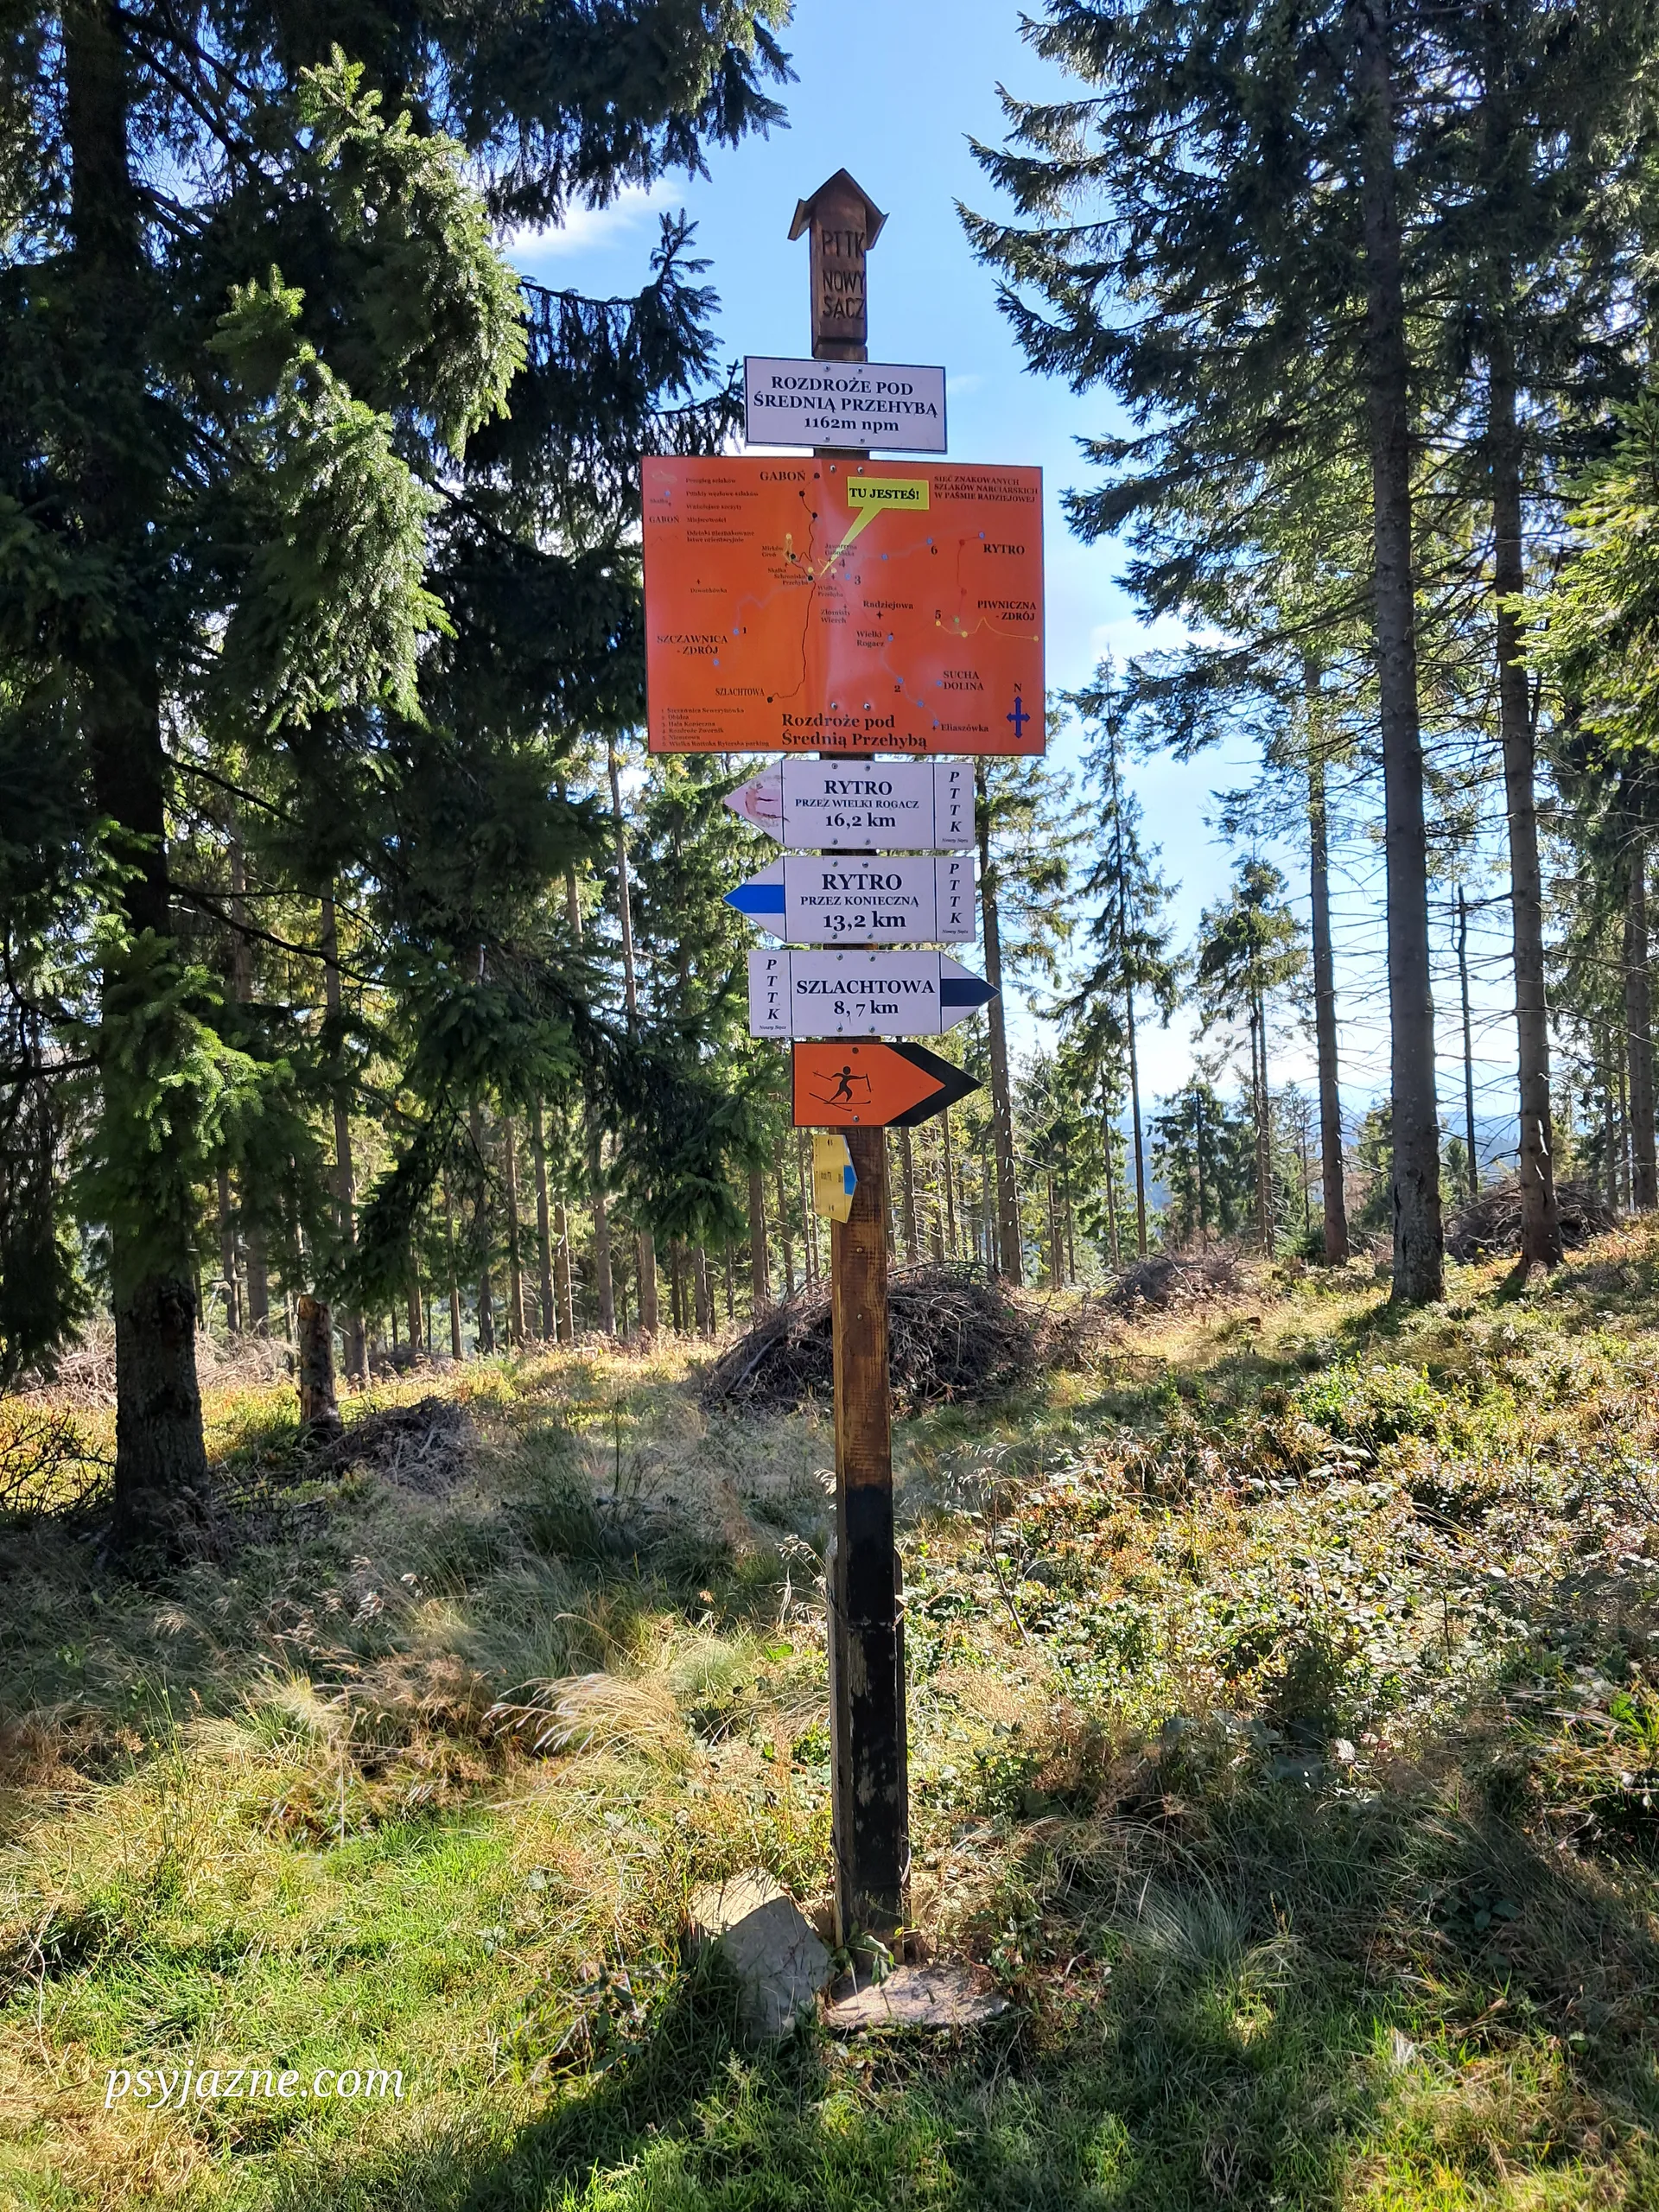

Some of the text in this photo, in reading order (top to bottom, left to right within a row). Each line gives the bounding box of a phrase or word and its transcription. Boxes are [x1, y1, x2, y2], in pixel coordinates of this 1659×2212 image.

[822, 230, 865, 258] PTTK
[823, 270, 866, 294] NOWY
[771, 375, 913, 396] ROZDROŻE POD
[753, 391, 938, 418] ŚREDNIĄ PRZEHYBĄ
[804, 416, 899, 434] 1162m npm
[759, 469, 806, 481] GABOŃ
[954, 476, 1019, 486] ZNAKOWANYCH
[849, 486, 920, 500] TU JESTEŚ!
[976, 485, 1038, 494] NARCIARSKICH
[944, 491, 976, 500] PAŚMIE
[977, 493, 1035, 503] RADZIEJOWEJ
[649, 514, 680, 524] GABOŃ
[931, 546, 938, 555] 6
[982, 543, 1026, 555] RYTRO
[838, 558, 846, 568] 4
[854, 575, 861, 585] 3
[862, 600, 914, 610] Radziejowa
[977, 600, 1037, 610] PIWNICZNA
[934, 610, 942, 619] 5
[1001, 610, 1035, 621] ZDRÓJ
[657, 634, 728, 644] SZCZAWNICA
[856, 639, 885, 648] Rogacz
[682, 645, 718, 655] ZDRÓJ
[943, 671, 980, 680] SUCHA
[715, 687, 765, 696] SZLACHTOWA
[943, 681, 984, 690] DOLINA
[1014, 683, 1022, 692] N
[781, 713, 895, 730] Rozdroże pod
[941, 723, 989, 732] Eliaszówka
[781, 729, 927, 750] Średnią Przehybą
[823, 779, 893, 795] RYTRO
[795, 798, 919, 809] PRZEZ WIELKI ROGACZ
[949, 771, 962, 833] PTTK
[825, 811, 896, 830] 16,2 km
[822, 873, 903, 890] RYTRO
[949, 863, 962, 924] PTTK
[800, 895, 919, 907] PRZEZ KONIECZNĄ
[823, 910, 906, 931] 13,2 km
[766, 959, 780, 1020] PTTK
[796, 979, 936, 995] SZLACHTOWA
[870, 999, 899, 1014] km
